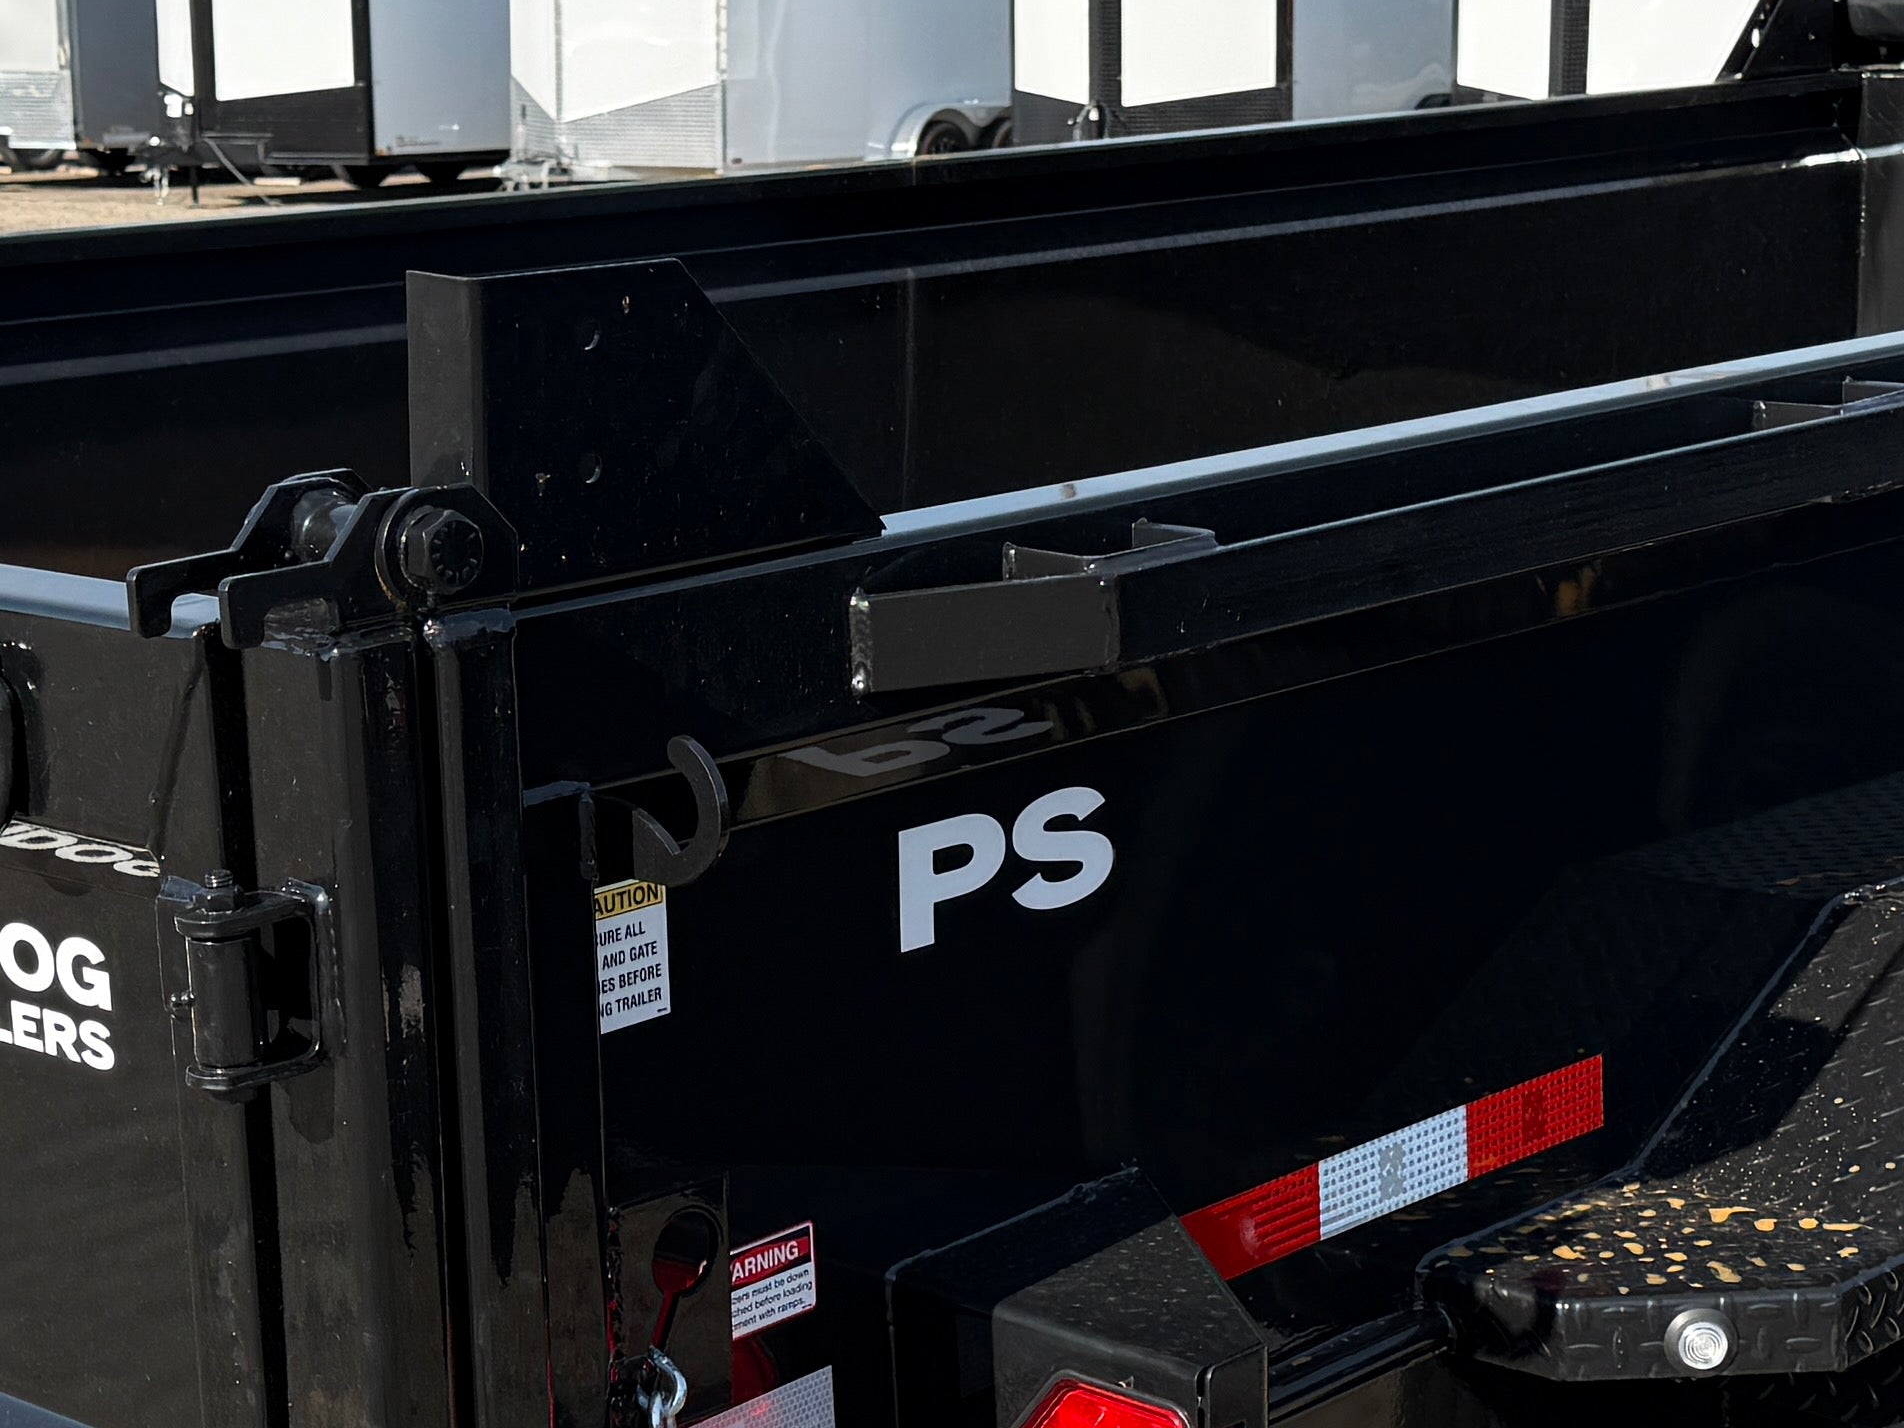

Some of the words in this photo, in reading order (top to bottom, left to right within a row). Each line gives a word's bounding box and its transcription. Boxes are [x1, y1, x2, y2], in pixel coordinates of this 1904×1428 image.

[898, 786, 1116, 953] PS
[595, 883, 659, 917] AUTION
[625, 921, 646, 940] ALL
[602, 950, 626, 971] AND
[629, 940, 658, 962] GATE
[619, 963, 662, 989] BEFORE
[615, 987, 662, 1013] TRAILER
[730, 1240, 799, 1283] ARNING
